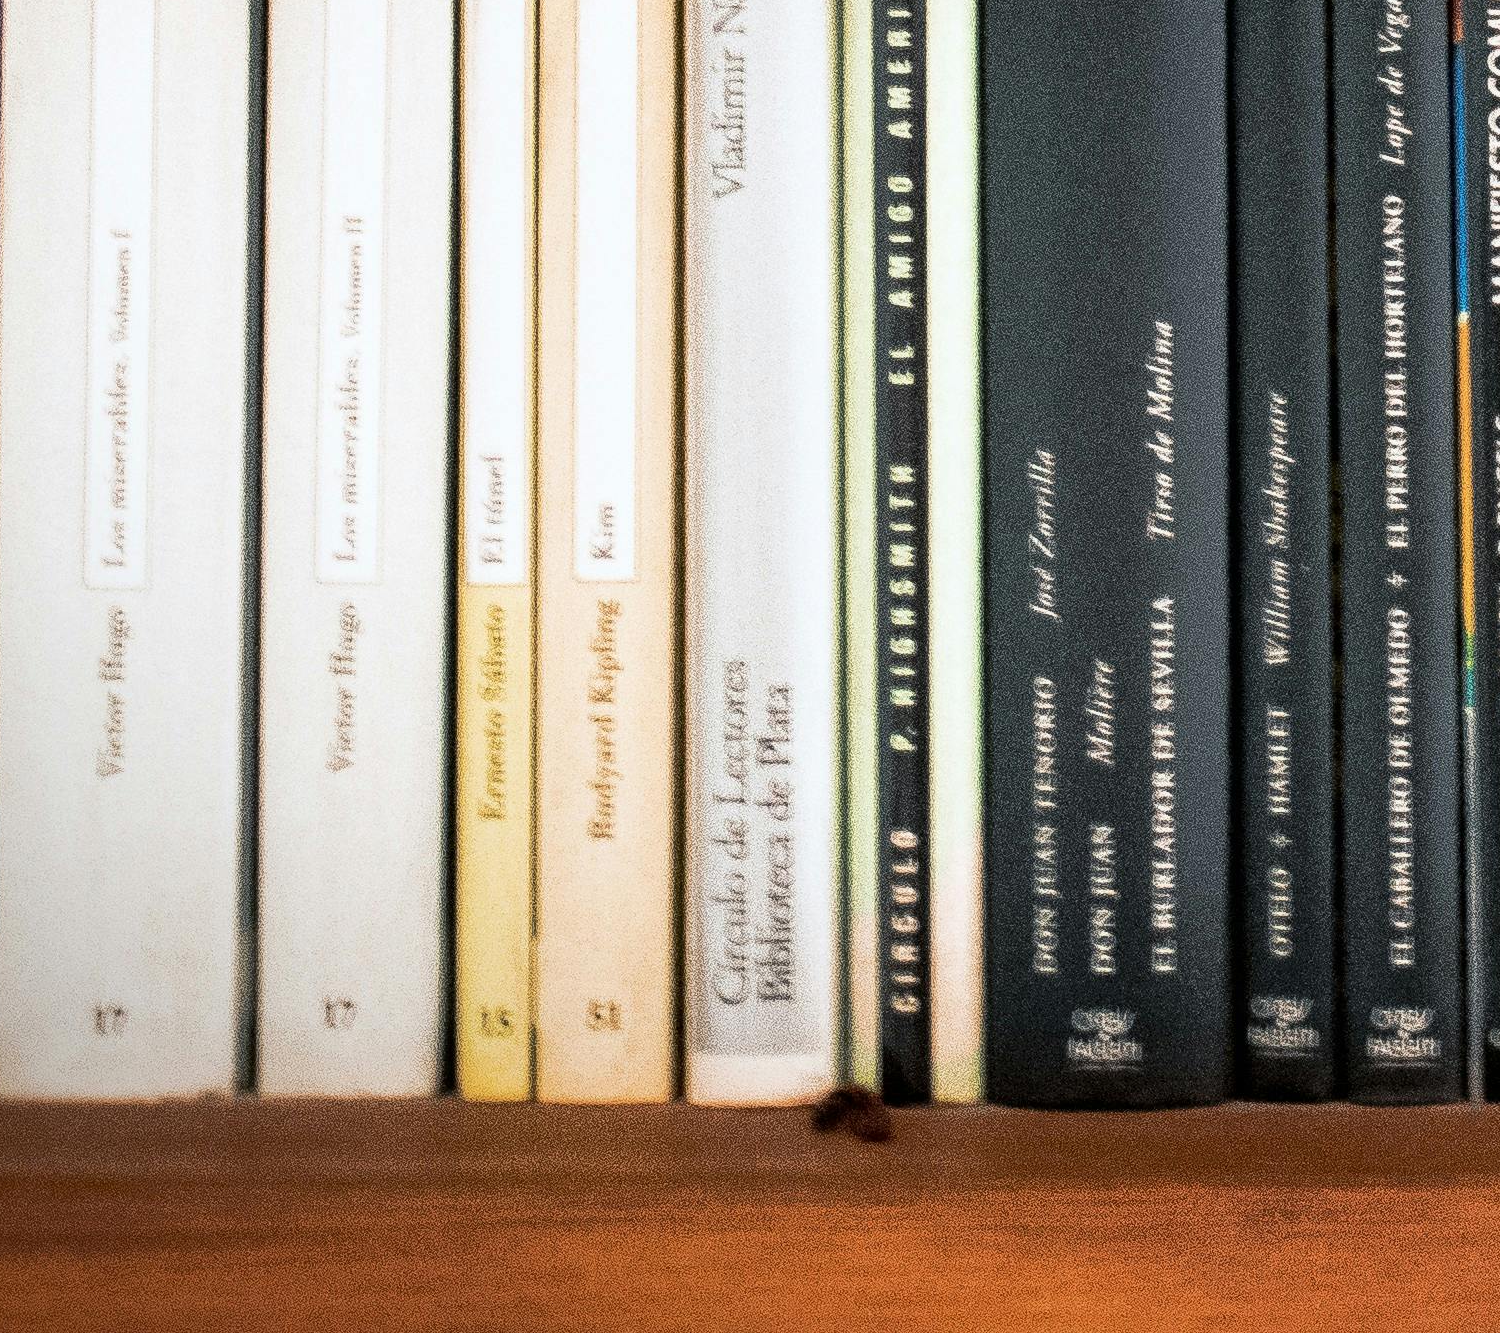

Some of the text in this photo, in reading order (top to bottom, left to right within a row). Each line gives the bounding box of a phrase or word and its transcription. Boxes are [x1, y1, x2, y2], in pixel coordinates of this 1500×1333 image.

[709, 48, 746, 200] Vladimir
[887, 176, 913, 308] AMIGO
[888, 345, 914, 385] EL
[889, 465, 915, 706] HIGHSMITH
[711, 661, 749, 1007] Círculo de Lectores
[754, 686, 795, 1004] Biblioteca de Plata
